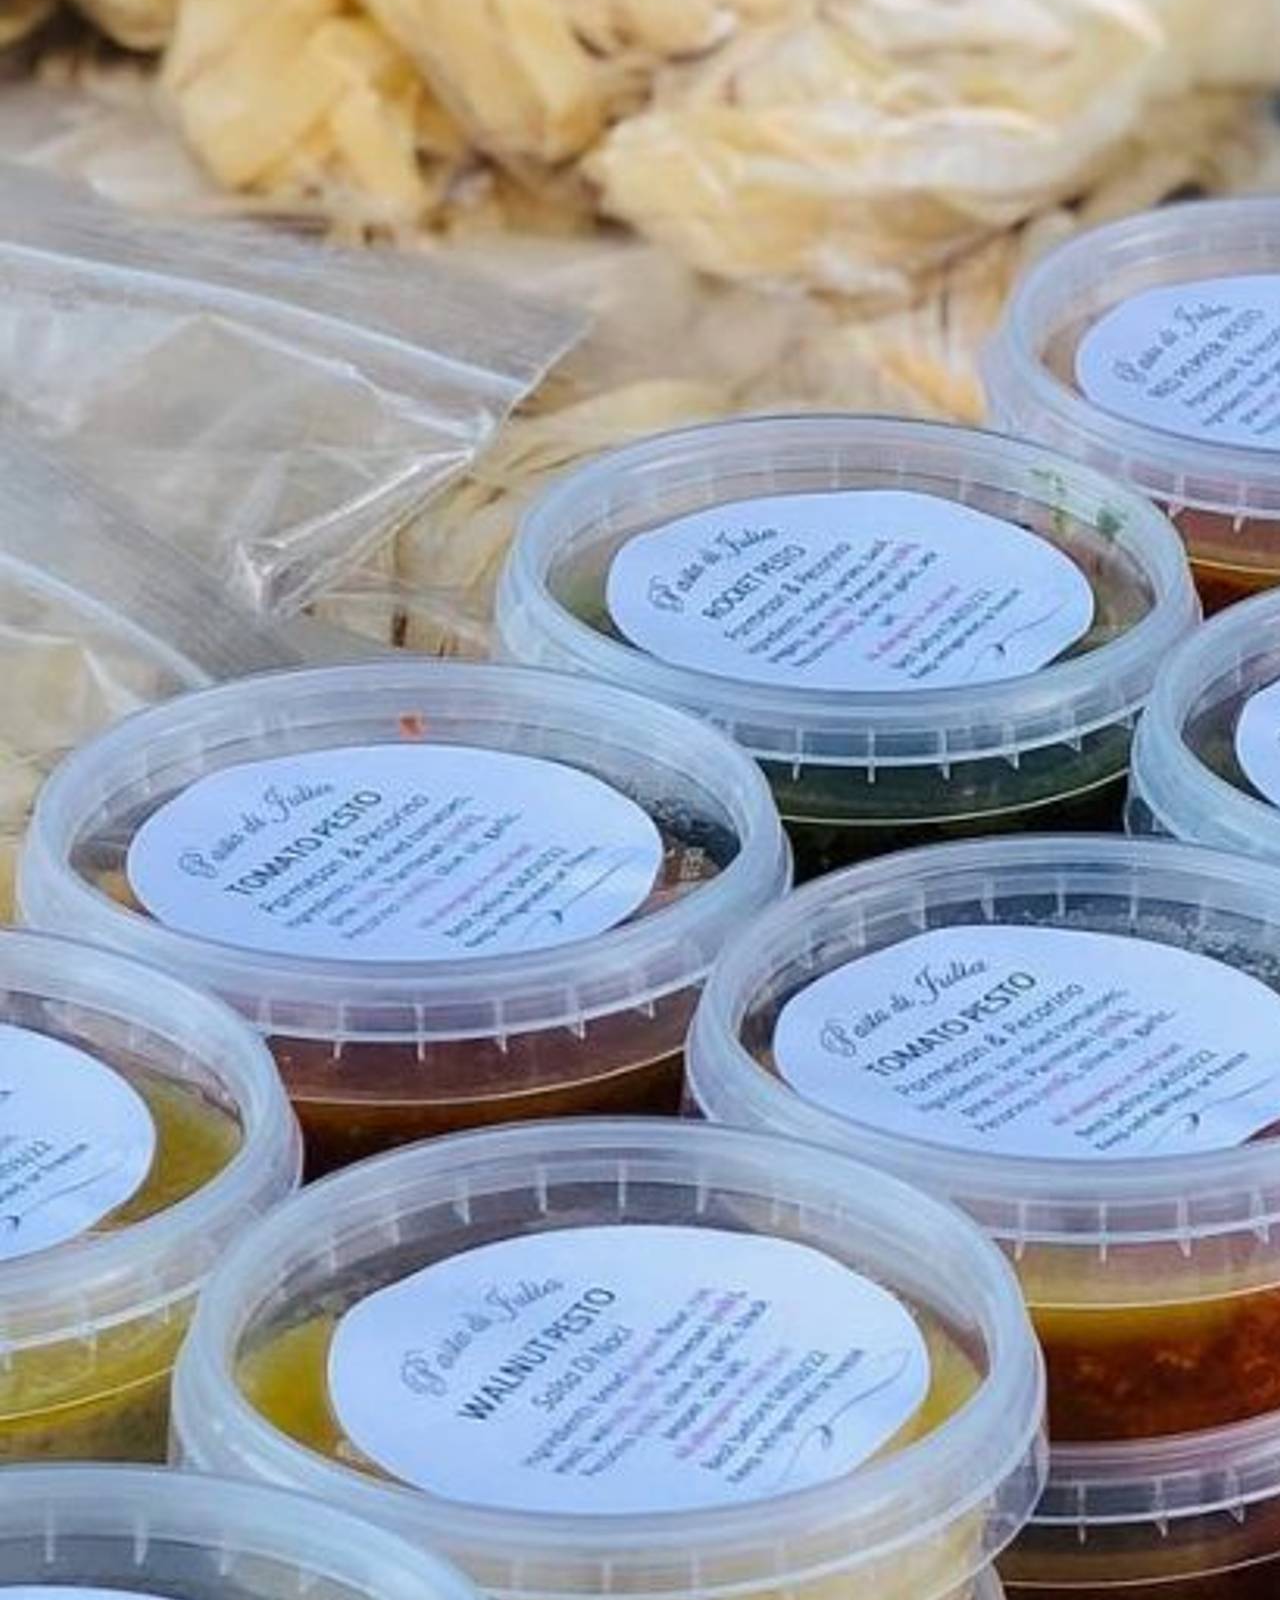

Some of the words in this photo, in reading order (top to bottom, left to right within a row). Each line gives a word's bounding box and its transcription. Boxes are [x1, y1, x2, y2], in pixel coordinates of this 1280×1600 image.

[1216, 308, 1267, 342] PESTO
[699, 572, 768, 620] ROCKET
[751, 543, 809, 577] PESTO
[224, 836, 325, 896] TOMATO
[310, 789, 384, 839] PESTO
[338, 847, 365, 859] &
[863, 1019, 972, 1077] TOMATO
[955, 971, 1041, 1023] PESTO
[892, 1044, 992, 1097] Parmesan
[980, 1032, 1010, 1047] &
[999, 983, 1087, 1036] Pecorino
[457, 1338, 555, 1421] WALNUT
[539, 1286, 618, 1342] PESTO
